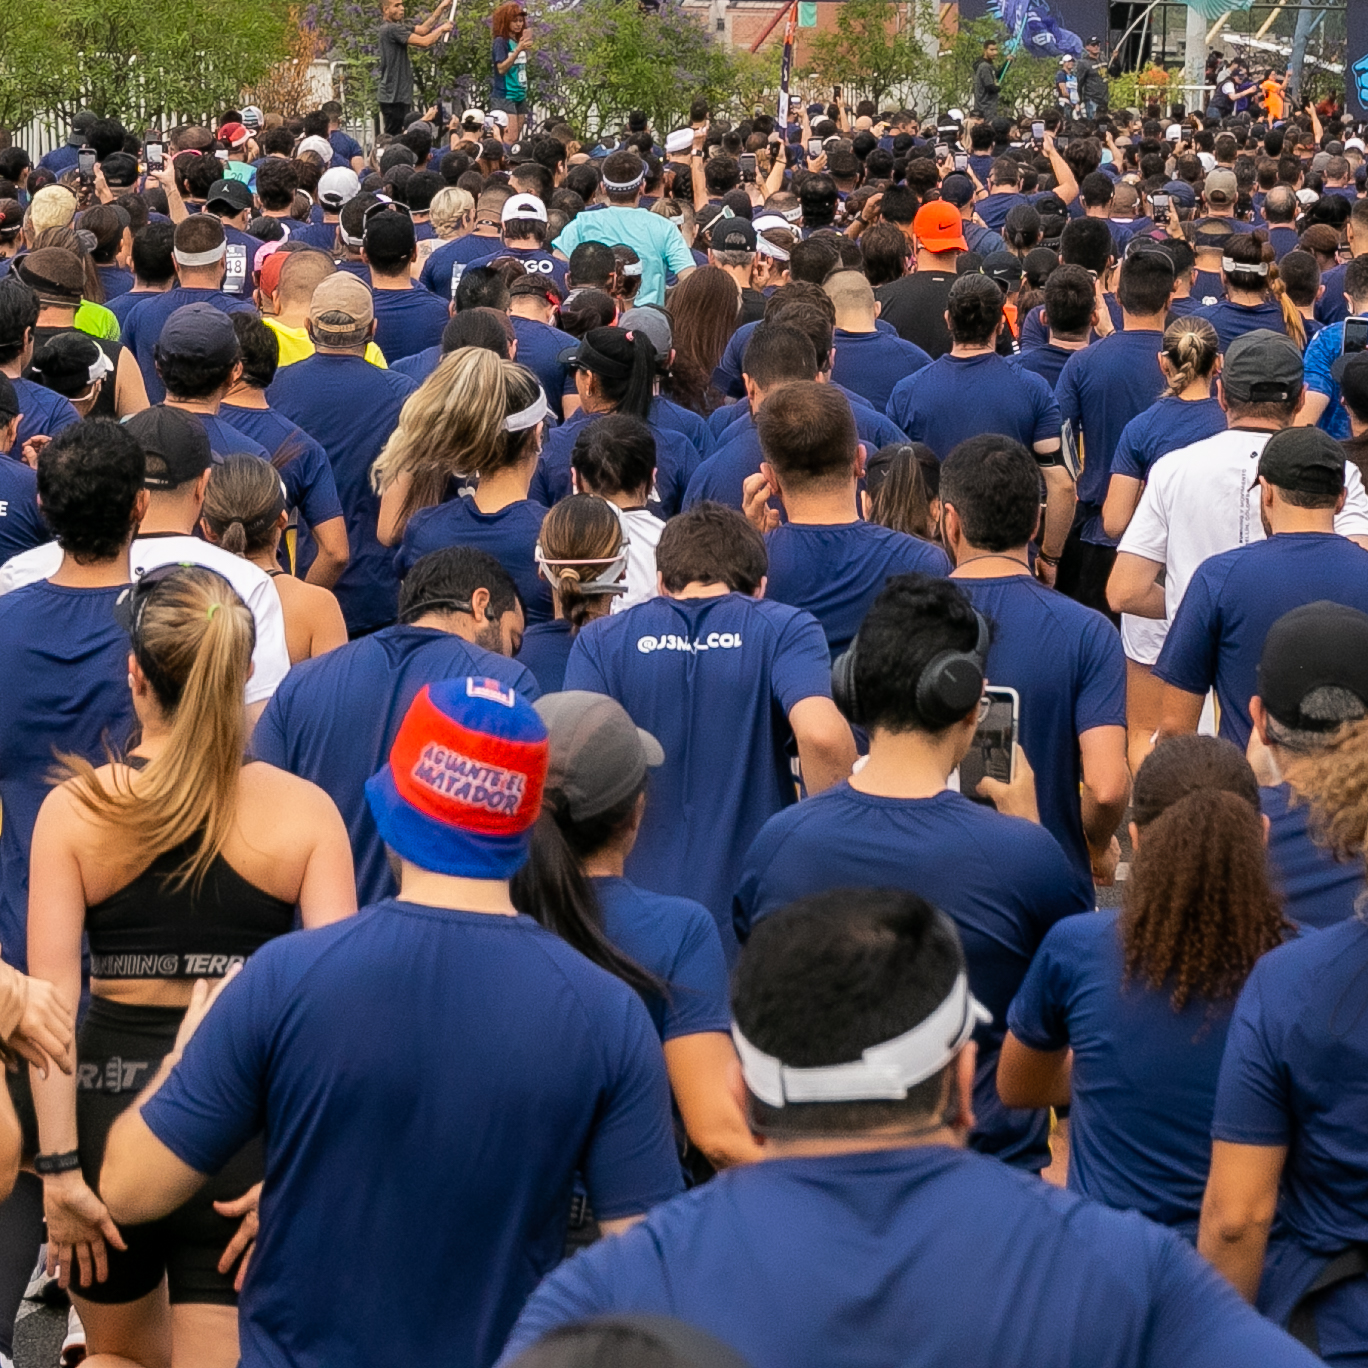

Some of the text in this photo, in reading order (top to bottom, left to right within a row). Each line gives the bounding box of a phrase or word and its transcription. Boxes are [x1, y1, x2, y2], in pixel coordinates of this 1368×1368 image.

[520, 260, 554, 274] GO
[423, 745, 504, 787] AGUANTE
[414, 762, 519, 816] MATADOR
